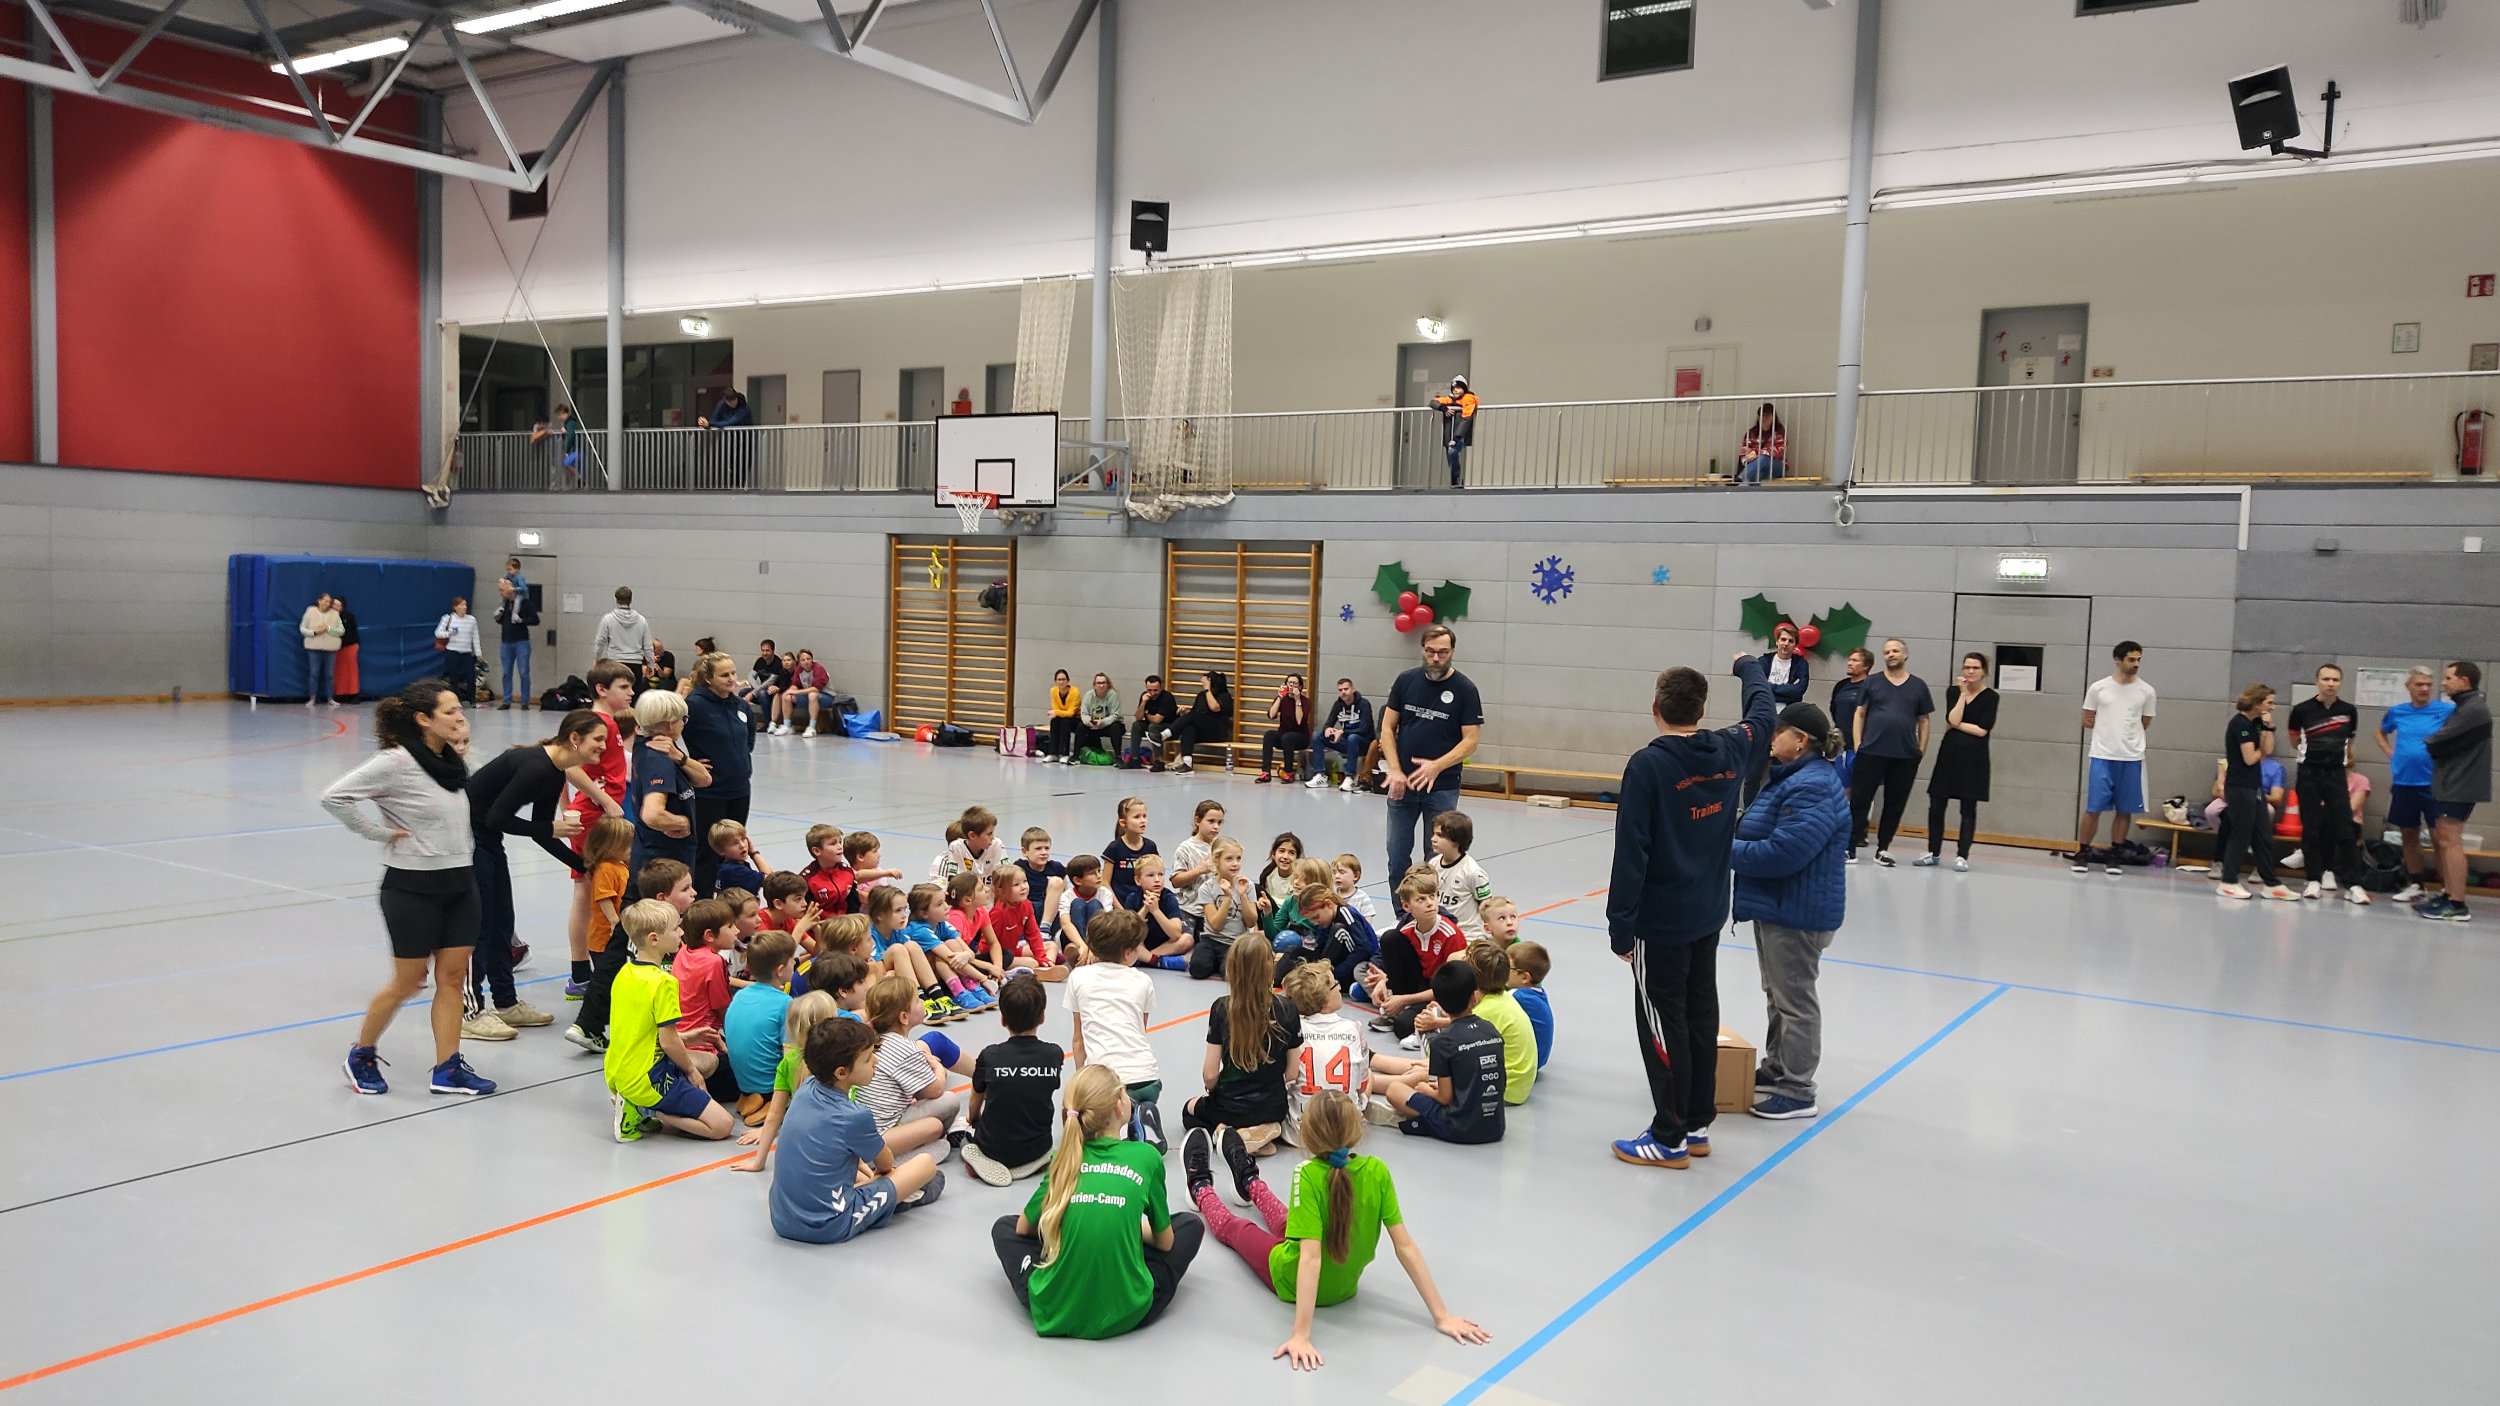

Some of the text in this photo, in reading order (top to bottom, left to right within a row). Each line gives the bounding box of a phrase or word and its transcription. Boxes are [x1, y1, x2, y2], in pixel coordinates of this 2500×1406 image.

[1690, 801, 1723, 819] Trainer
[1304, 1032, 1326, 1041] AYERN
[994, 1066, 1058, 1077] TSV SOLLN
[1299, 1046, 1352, 1095] 14
[1080, 1162, 1144, 1186] Großhadern
[1070, 1192, 1127, 1208] erien-Camp
